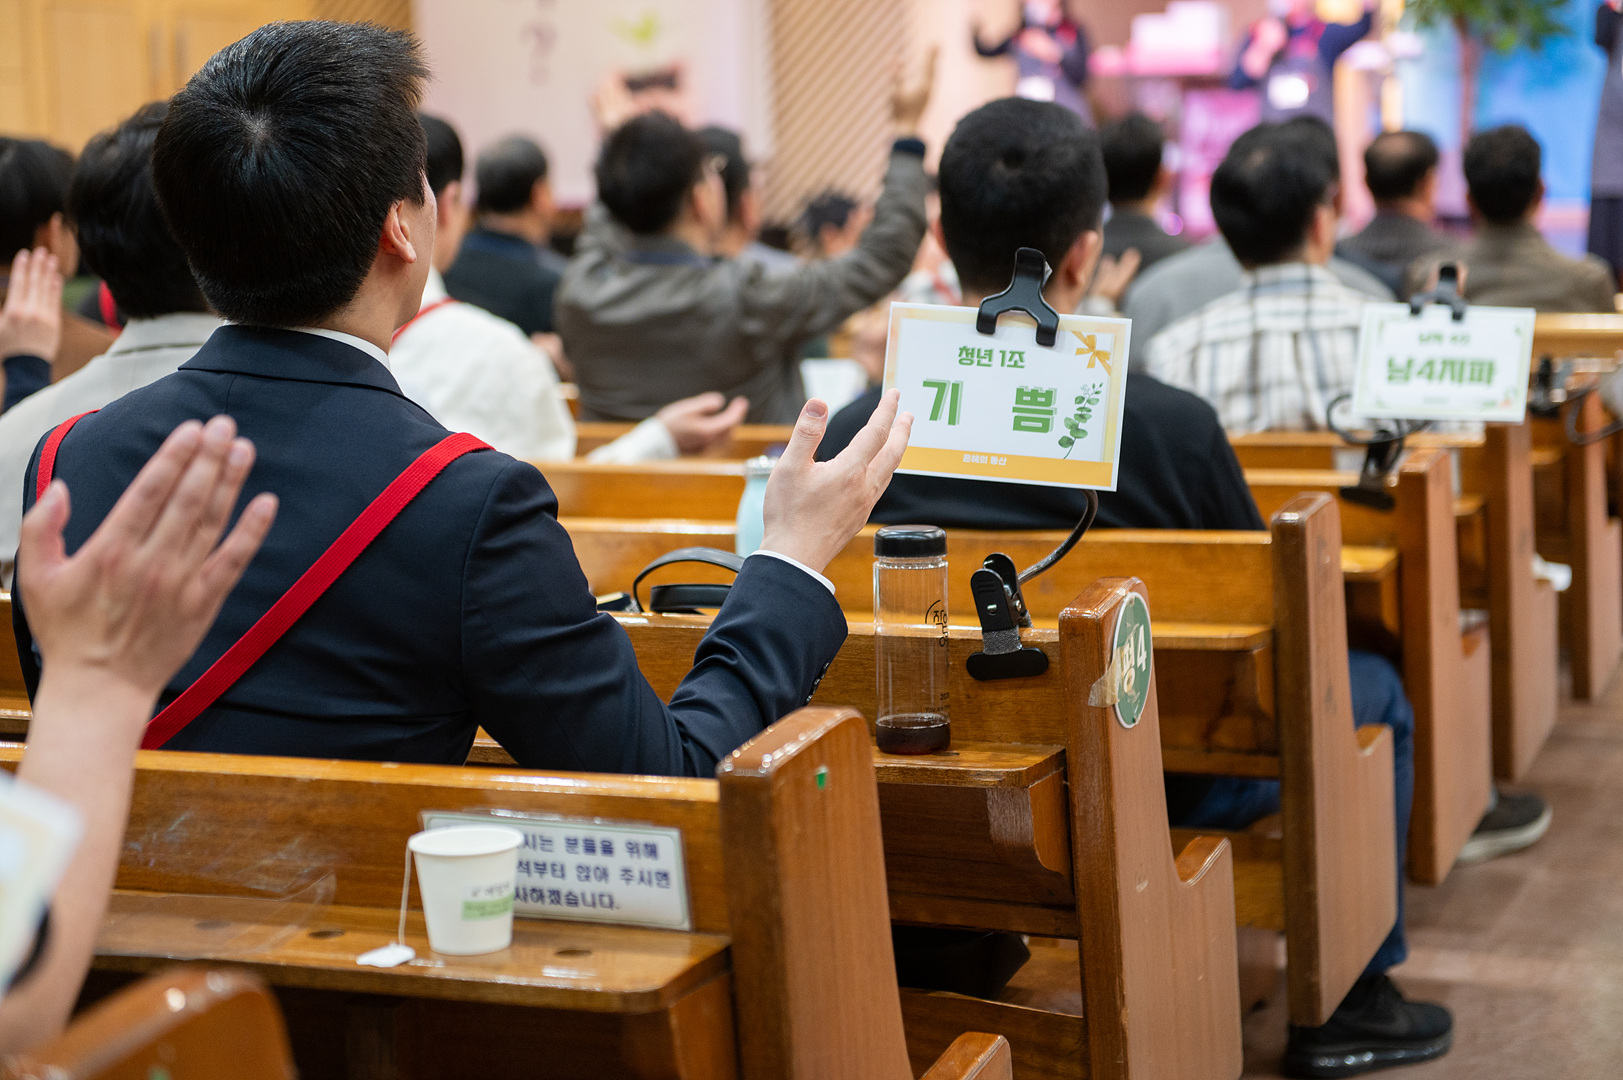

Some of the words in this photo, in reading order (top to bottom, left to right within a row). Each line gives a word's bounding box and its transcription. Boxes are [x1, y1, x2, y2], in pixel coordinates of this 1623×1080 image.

[957, 345, 994, 368] 청년
[998, 350, 1026, 369] 1조
[962, 453, 988, 465] 은혜의
[516, 833, 554, 853] 시는
[565, 835, 615, 858] 분들을
[624, 838, 660, 861] 위해
[516, 859, 566, 881] 석부터
[575, 863, 610, 884] 앉아
[619, 866, 672, 890] 주시면
[513, 886, 621, 911] 사하겠습니다.
